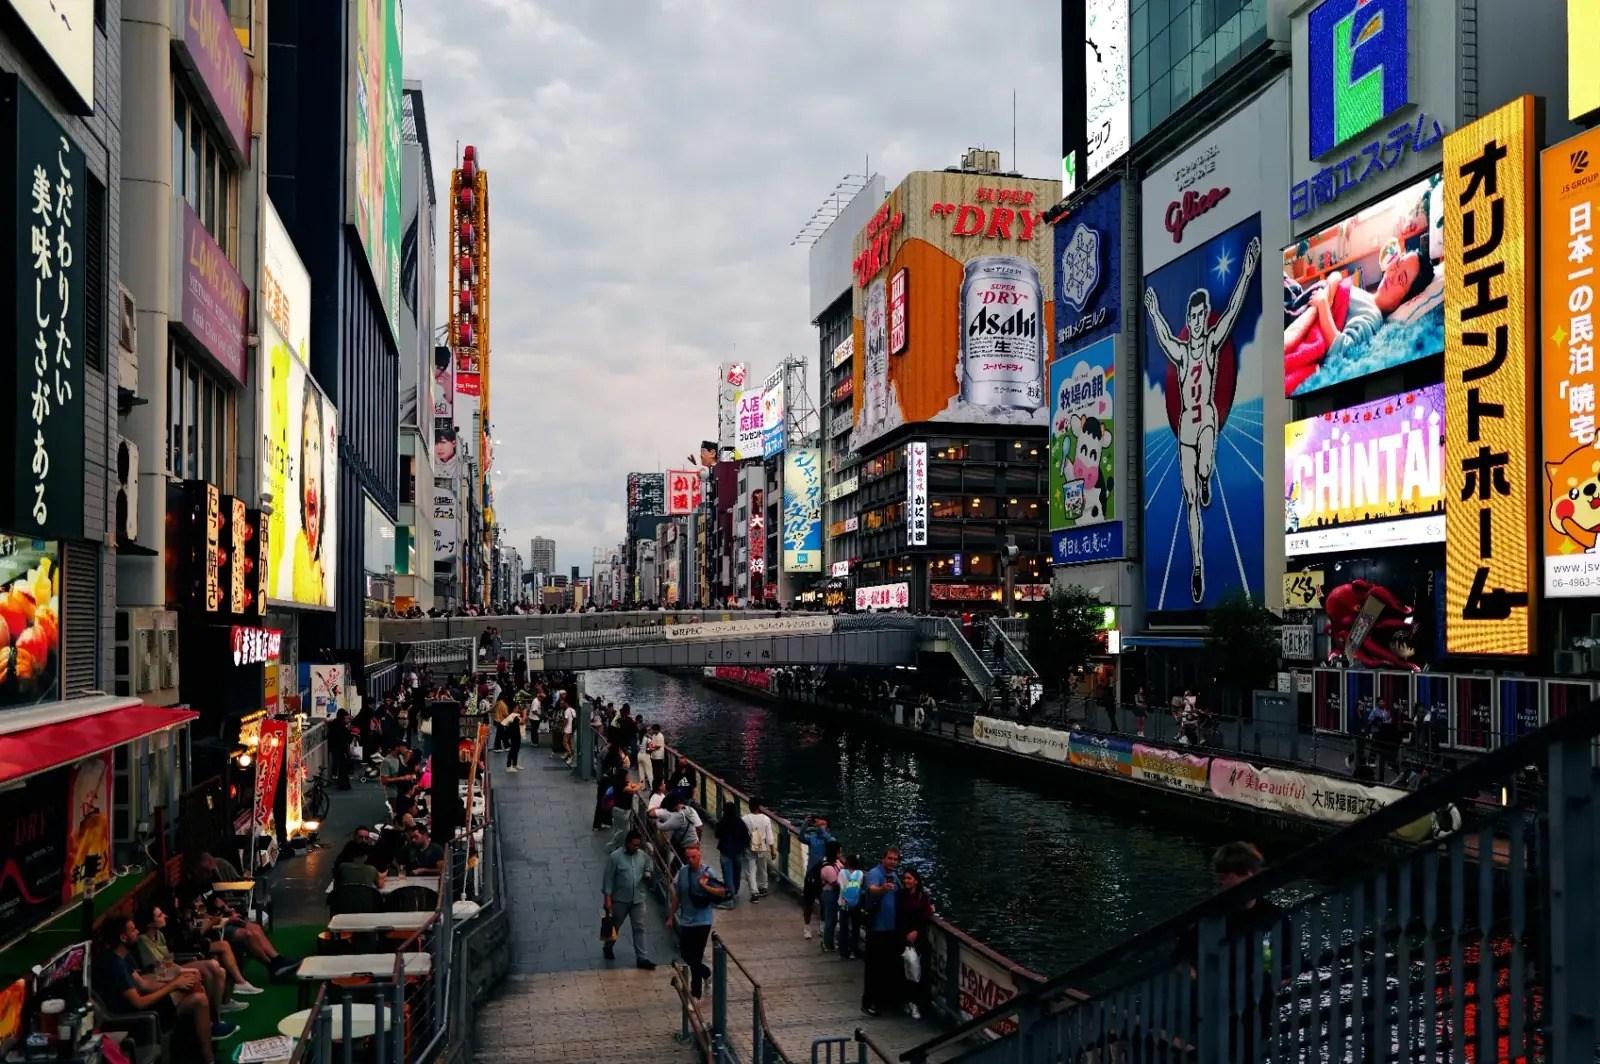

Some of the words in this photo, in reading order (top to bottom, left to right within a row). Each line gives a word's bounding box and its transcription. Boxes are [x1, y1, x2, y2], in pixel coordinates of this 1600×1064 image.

[1289, 112, 1443, 221] 日商エステム
[1560, 184, 1570, 194] JS
[1571, 173, 1600, 190] GROUP
[976, 187, 1034, 205] SUPER
[1164, 186, 1231, 244] Glico
[56, 135, 74, 406] こだわりたい
[990, 283, 1016, 292] SUPER
[968, 305, 1036, 339] Asahi
[31, 163, 54, 527] 美味しさがある
[994, 340, 1012, 354] 生
[982, 363, 1024, 373] スーパードライ
[1460, 139, 1512, 621] オリエントホーム
[740, 396, 760, 415] 入店
[1060, 374, 1104, 411] 牧場の朝
[1190, 360, 1203, 425] グリコ
[1293, 407, 1441, 519] CHINTAI
[258, 516, 268, 614] 串かつ
[1290, 575, 1316, 604] くくる
